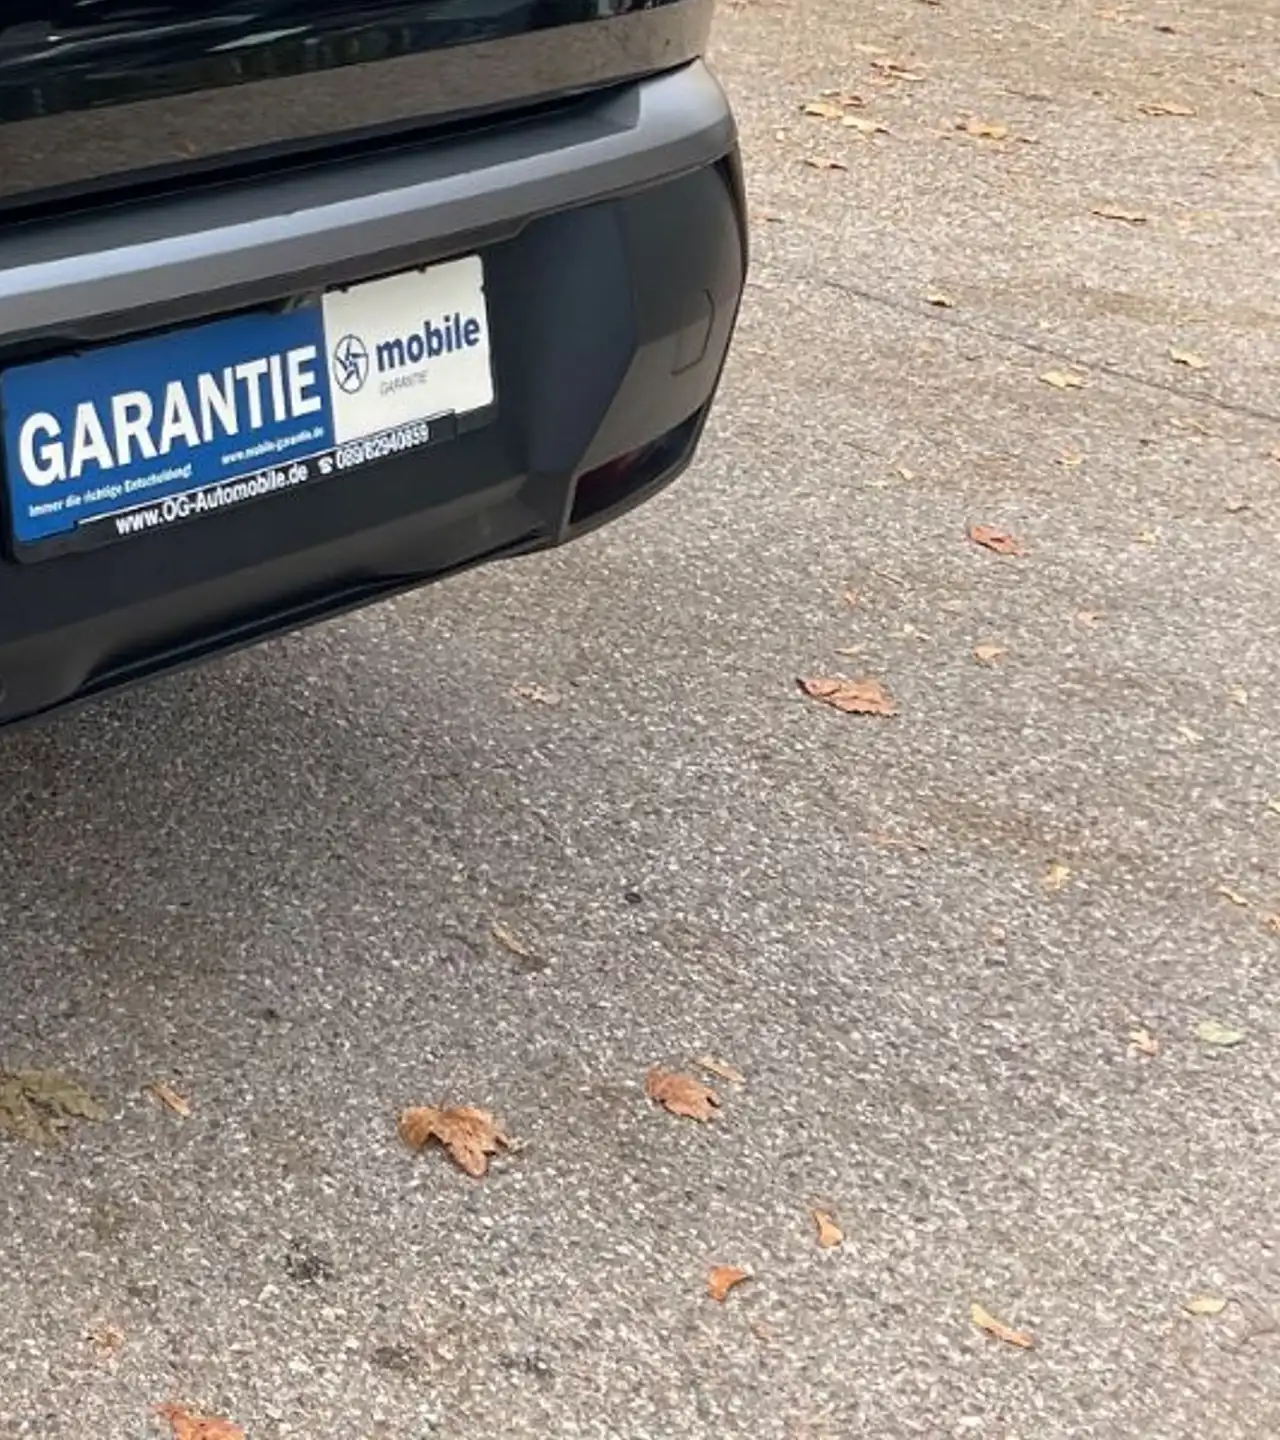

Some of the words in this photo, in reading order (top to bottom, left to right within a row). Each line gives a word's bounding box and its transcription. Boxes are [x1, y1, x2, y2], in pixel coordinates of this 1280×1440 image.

[375, 312, 480, 372] mobile
[379, 369, 429, 396] GARANTIE
[19, 345, 323, 487] GARANTIE
[65, 494, 82, 510] die
[83, 481, 123, 505] richtige
[115, 463, 309, 535] www.OG-Automobile.de
